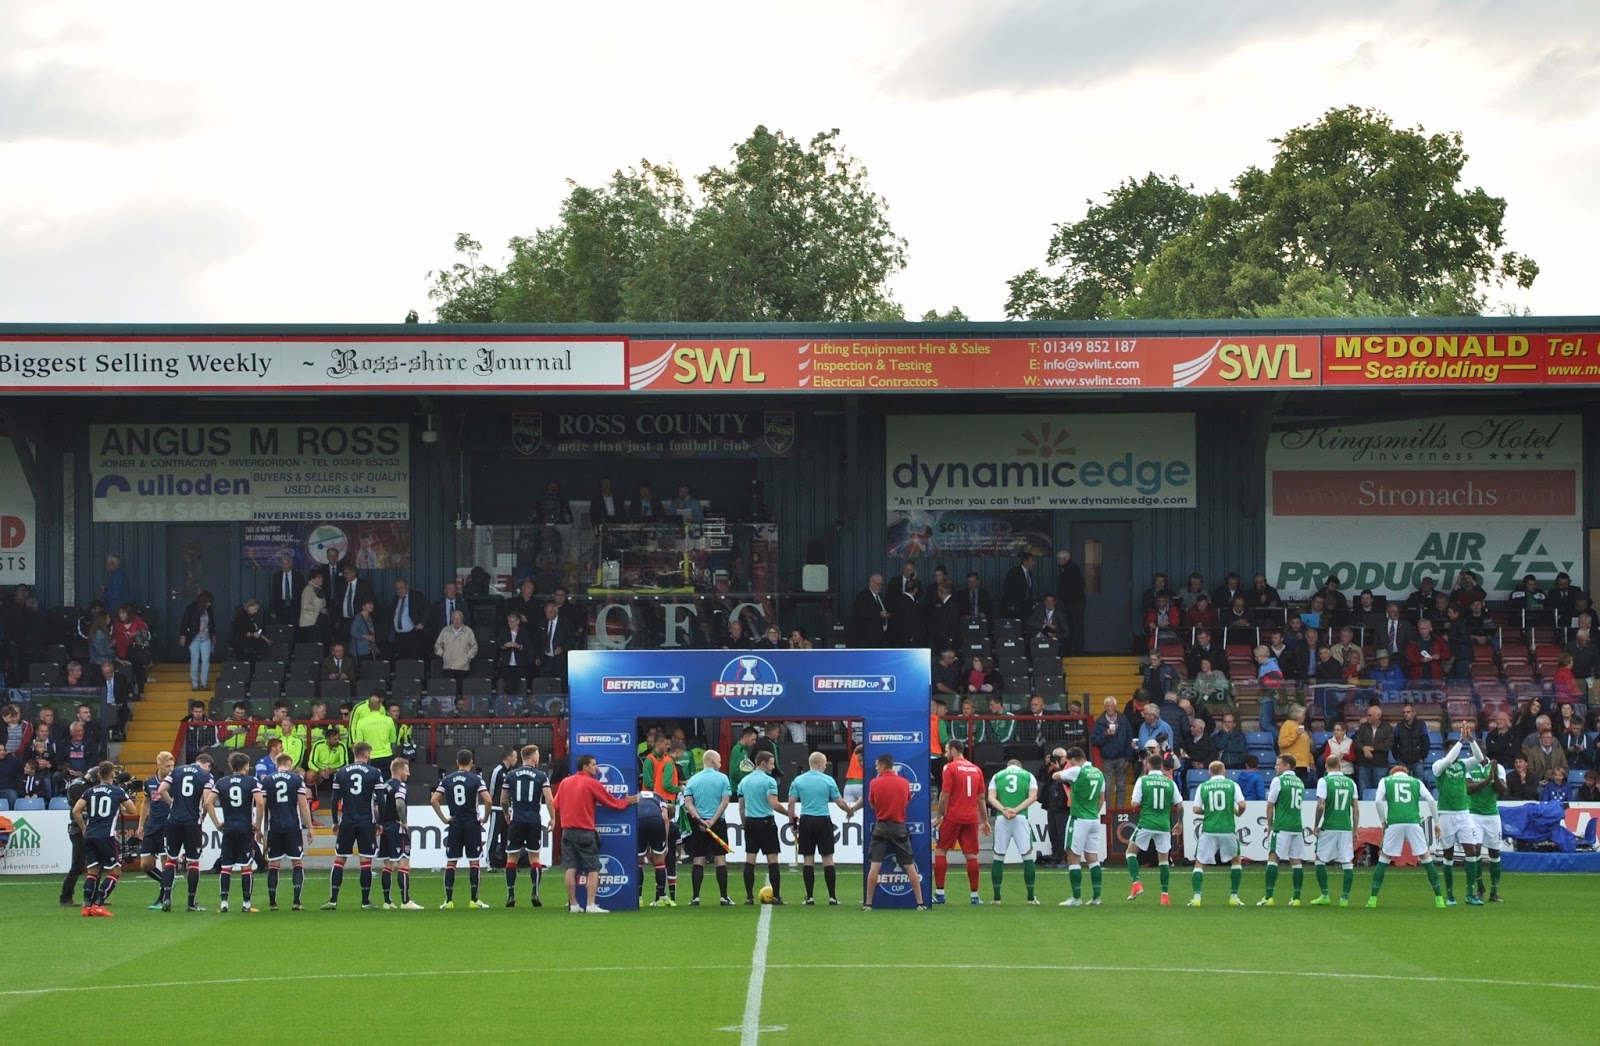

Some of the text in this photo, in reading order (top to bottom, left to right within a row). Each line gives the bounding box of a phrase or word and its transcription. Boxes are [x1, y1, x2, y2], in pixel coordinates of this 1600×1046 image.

[814, 343, 990, 357] Lifting Equipment Hire & Sales
[1028, 341, 1137, 353] T: 01349 852 187
[1547, 338, 1587, 356] Tel.
[0, 348, 572, 378] Biggest Selling Weekly Ross-shire Journal
[674, 347, 765, 383] SWL
[813, 359, 932, 373] Inspection & Testing
[1029, 358, 1139, 371] E: info@swlint.com
[1218, 344, 1312, 380] SWL
[1364, 361, 1500, 382] Scaffolding
[813, 376, 938, 387] Electrical Contractors
[1023, 375, 1141, 386] W: www.swlint.com
[559, 413, 626, 434] ROSS
[636, 413, 749, 434] COUNTY
[100, 426, 400, 456] ANGUS M ROSS
[557, 440, 750, 453] more than just a football club
[1280, 418, 1563, 461] Kingsmills Hotel
[100, 458, 400, 468] JOINER & CONTRACTOR INVERGORDON TEL 01349 852133
[1370, 451, 1473, 461] inverness
[253, 472, 408, 482] BUYERS & SELLERS OF QUALITY
[892, 452, 1190, 496] dynamicedge
[95, 474, 250, 498] Culloden
[284, 485, 311, 495] USED
[314, 485, 341, 495] CARS
[343, 485, 350, 494] &
[1359, 480, 1498, 506] Stronachs
[174, 498, 250, 520] sales
[311, 500, 359, 511] Service
[363, 500, 408, 511] Station
[916, 496, 925, 506] IT
[928, 496, 964, 508] partner
[968, 498, 986, 508] you
[997, 497, 1009, 506] can
[1049, 494, 1188, 507] www.dynamicedge.com
[253, 511, 407, 520] INVERNESS 01463 792211
[1415, 532, 1486, 560] AIR
[1276, 561, 1485, 591] PRODUCTS
[606, 679, 655, 690] BETFRED
[715, 683, 783, 696] BETFRED
[817, 679, 867, 689] BETFRED
[740, 699, 758, 708] CUP
[579, 735, 612, 743] BETFRED
[871, 734, 904, 742] BETFRED
[181, 775, 194, 797] 6
[275, 781, 289, 803] 2
[350, 773, 363, 795] 3
[516, 780, 535, 802] 11
[966, 776, 972, 797] 1
[1005, 774, 1018, 793] 3
[1089, 780, 1099, 800] 7
[1394, 782, 1411, 803] 15
[229, 786, 242, 807] 9
[453, 784, 466, 806] 8
[1153, 788, 1164, 809] 11
[1208, 790, 1226, 811] 10
[1291, 787, 1303, 809] 16
[1334, 789, 1350, 810] 17
[90, 795, 112, 818] 10
[1117, 814, 1129, 822] 22
[6, 849, 40, 857] ESTATES
